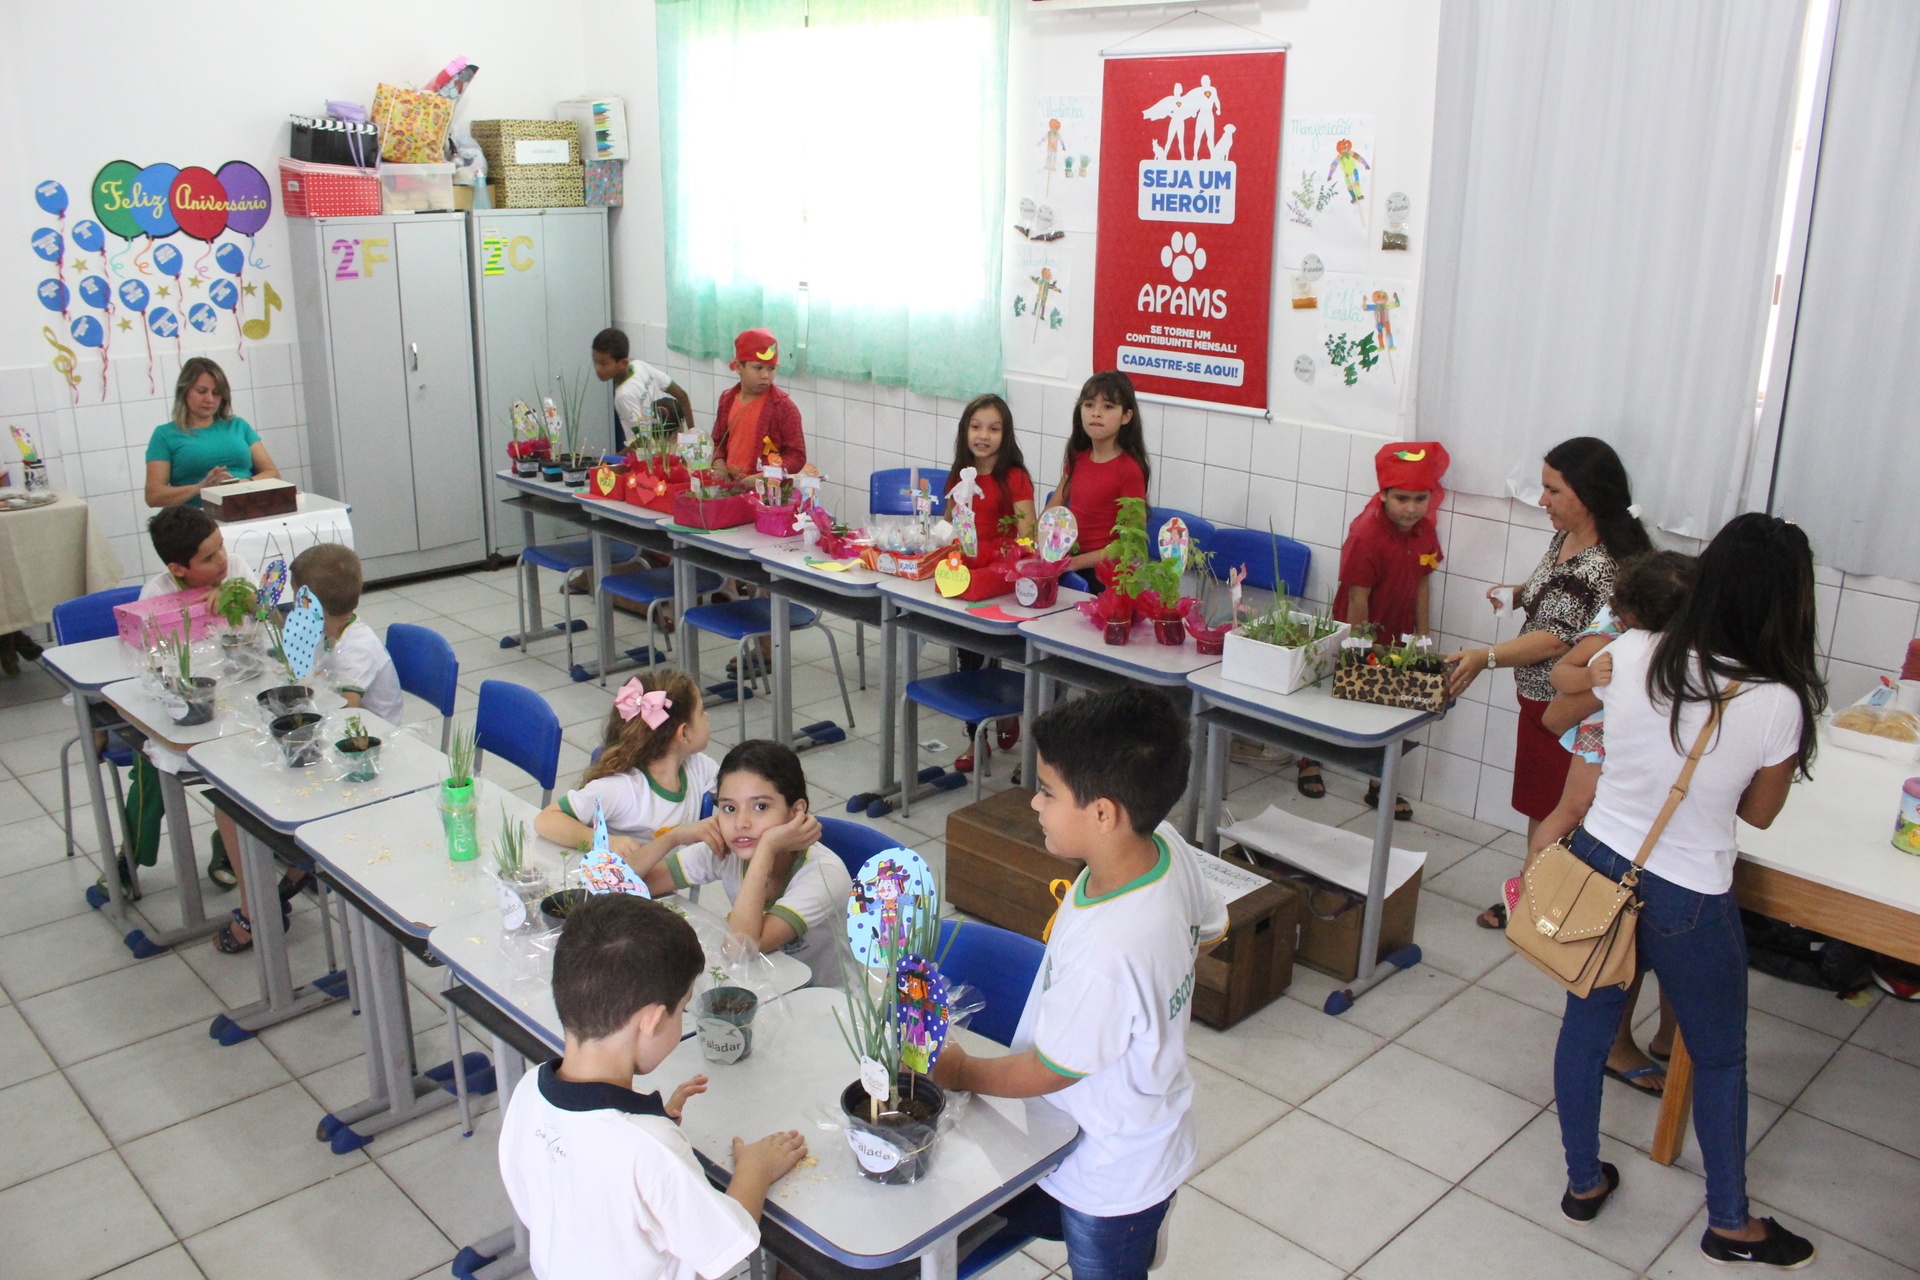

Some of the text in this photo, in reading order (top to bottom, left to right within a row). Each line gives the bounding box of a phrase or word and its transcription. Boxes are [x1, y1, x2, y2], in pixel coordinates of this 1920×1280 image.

[1291, 116, 1353, 152] Manjericão
[1143, 169, 1231, 190] SEJA UM
[101, 179, 267, 219] Feliz Aniversário
[1151, 189, 1221, 214] HERÓI!
[1137, 283, 1228, 320] APAMS
[1126, 332, 1237, 353] CONTRIBUINTE MENSAL!
[1150, 325, 1211, 340] SE TORNE UM
[1122, 354, 1239, 379] CADASTRE-SE AQUI!
